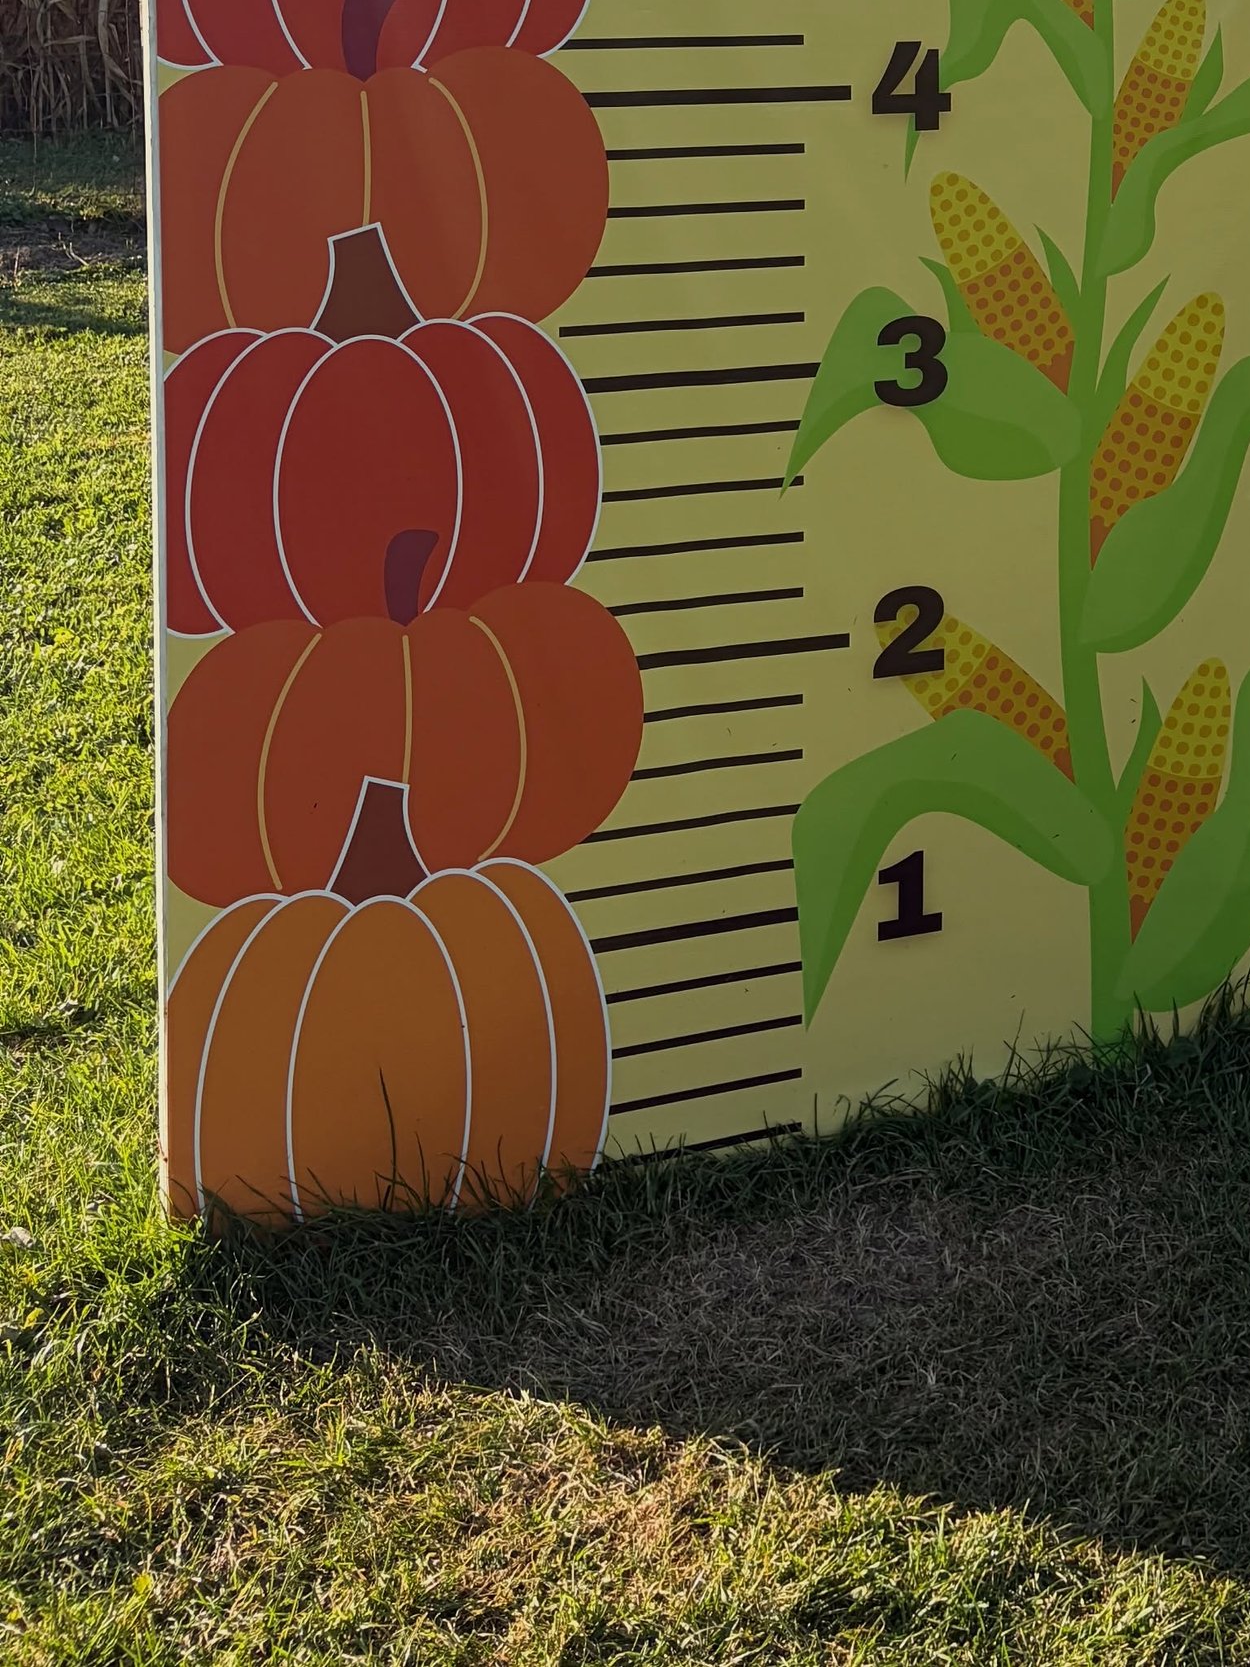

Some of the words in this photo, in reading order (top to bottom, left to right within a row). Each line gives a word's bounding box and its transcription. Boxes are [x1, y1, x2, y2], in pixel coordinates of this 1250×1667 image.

[872, 41, 952, 131] 4
[874, 315, 948, 407] 3
[873, 585, 945, 679] 2
[877, 850, 943, 942] 1
